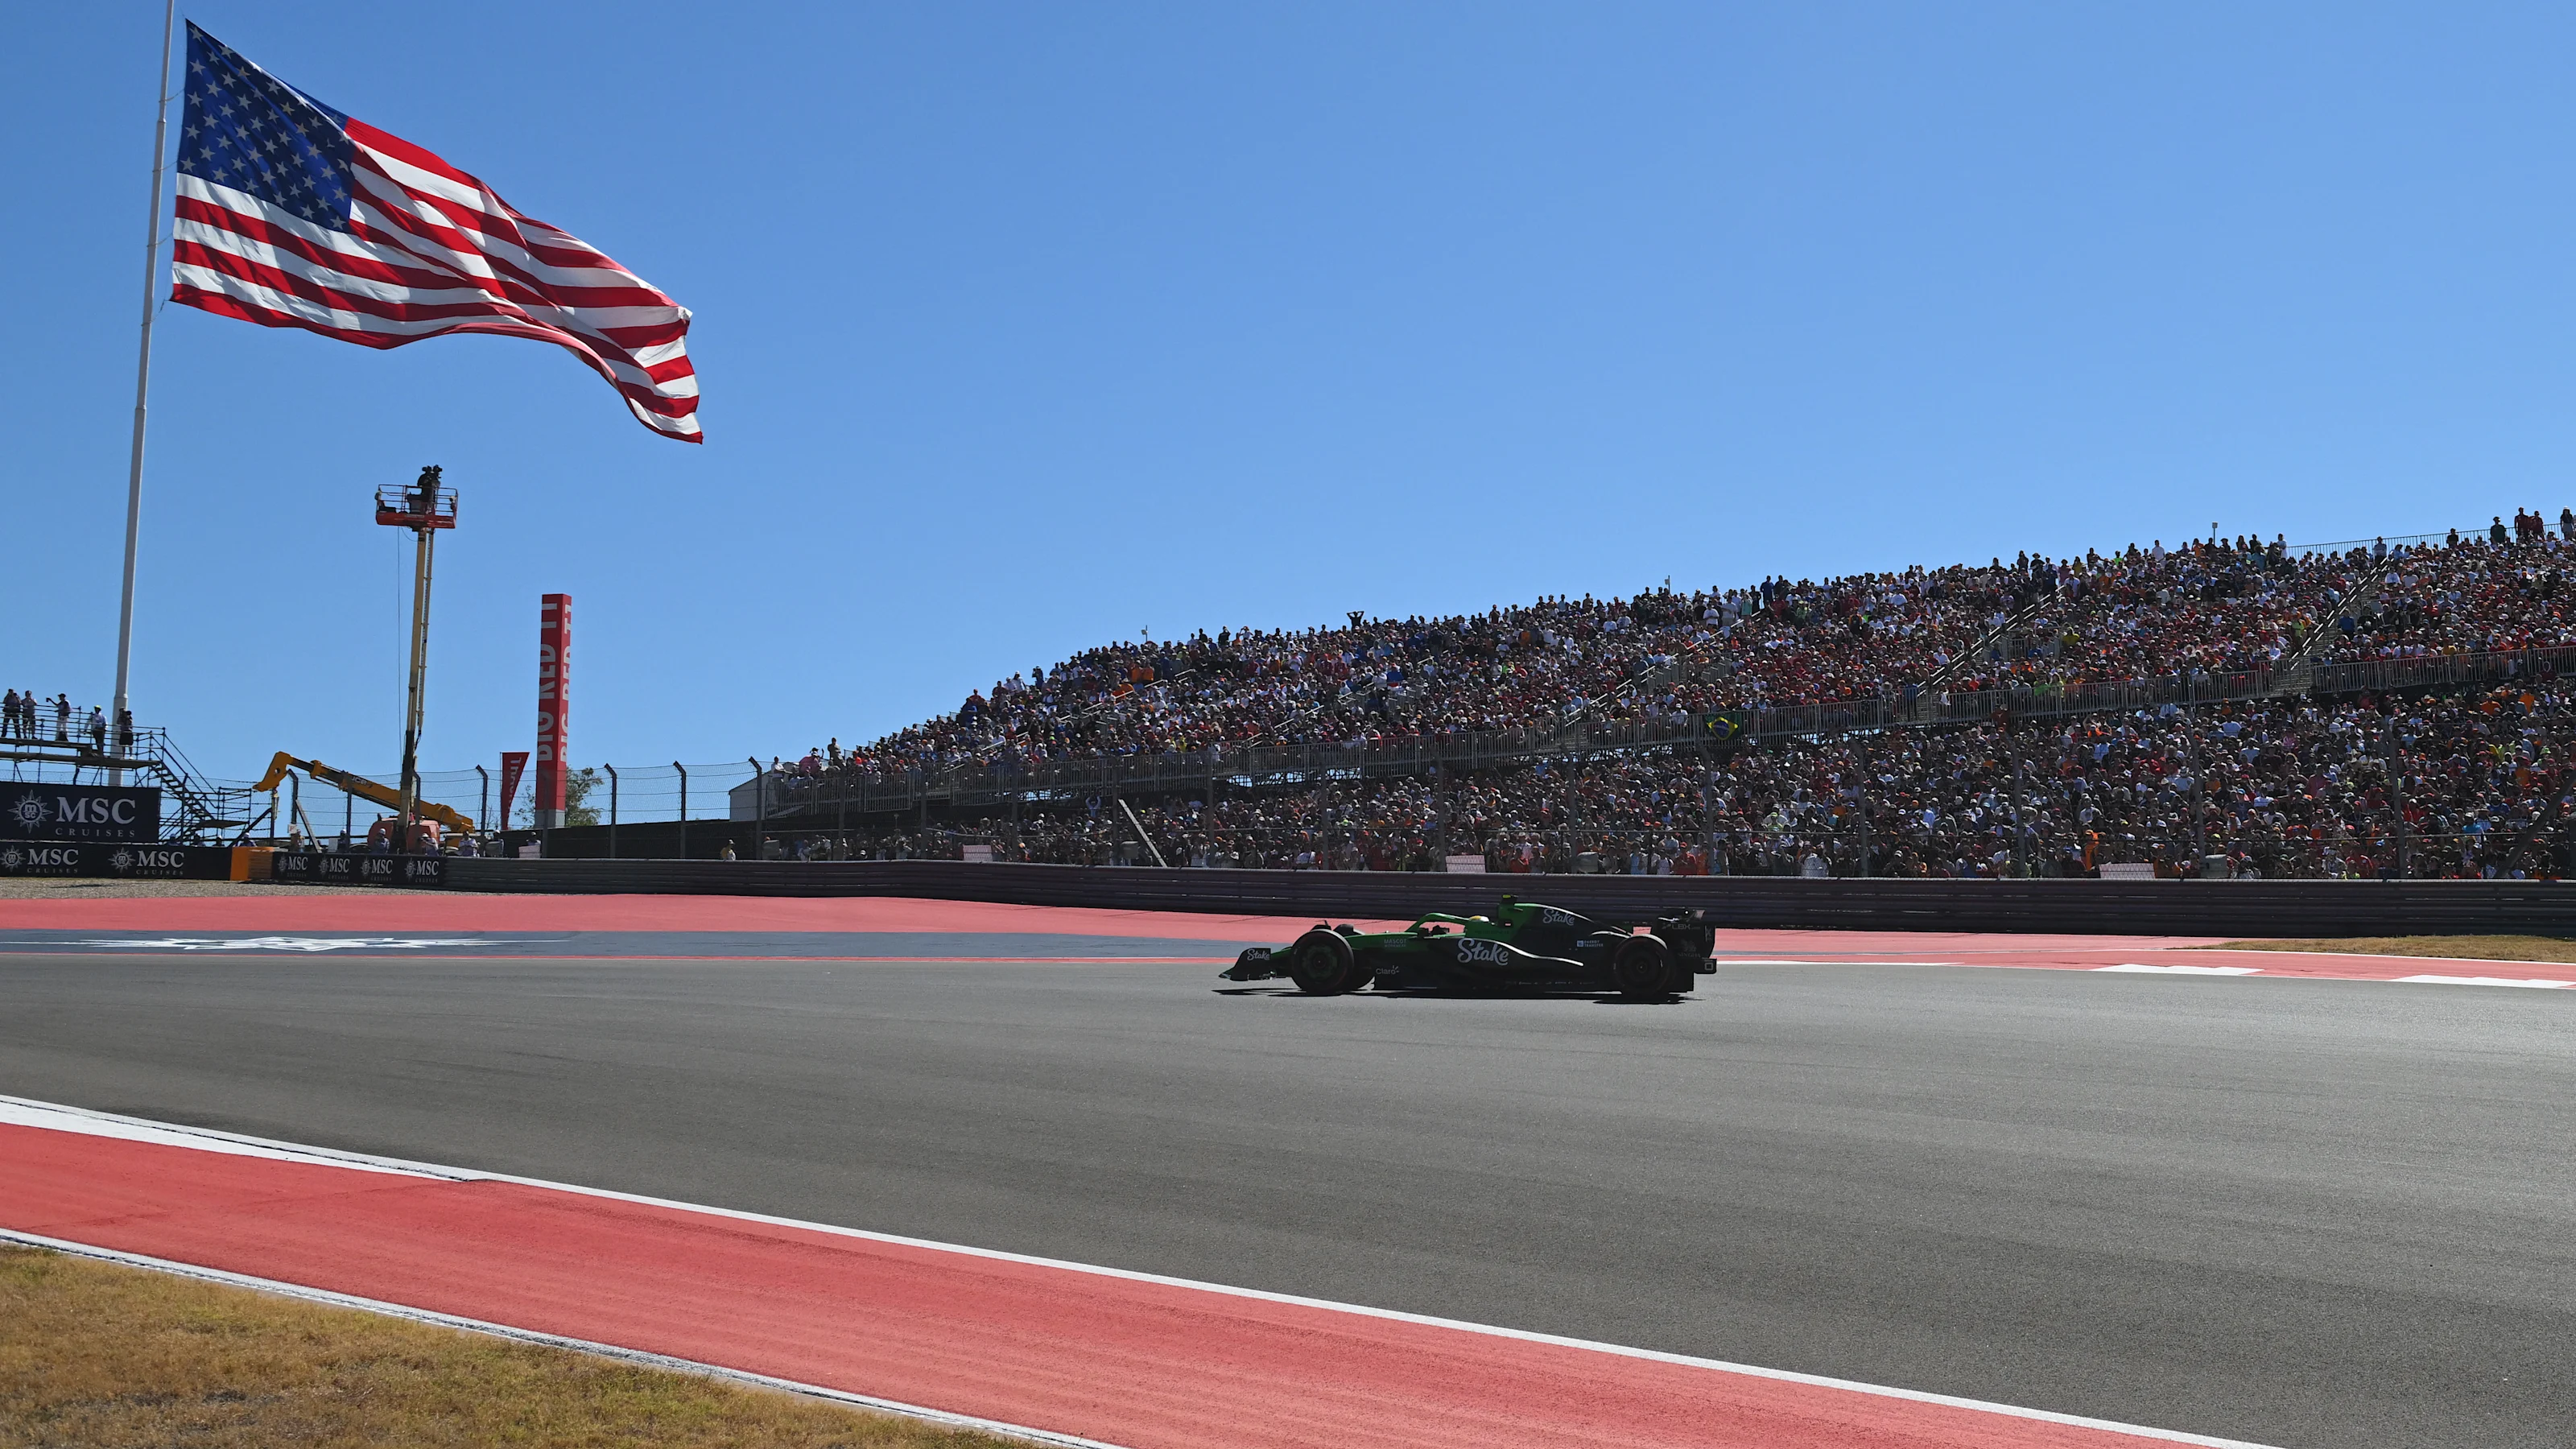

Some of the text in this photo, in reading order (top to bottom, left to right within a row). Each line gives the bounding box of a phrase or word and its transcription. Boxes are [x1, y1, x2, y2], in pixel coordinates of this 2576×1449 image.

[56, 796, 136, 824] MSC
[55, 828, 135, 837] CRUISES
[27, 848, 79, 865] MSC
[136, 850, 184, 868] MSC
[287, 856, 308, 870] MSC
[328, 858, 350, 873] MSC
[371, 859, 394, 874] MSC
[415, 861, 440, 876] MSC
[1542, 908, 1575, 926] Stake
[1247, 948, 1270, 960] Stake
[1457, 938, 1509, 966] Stake
